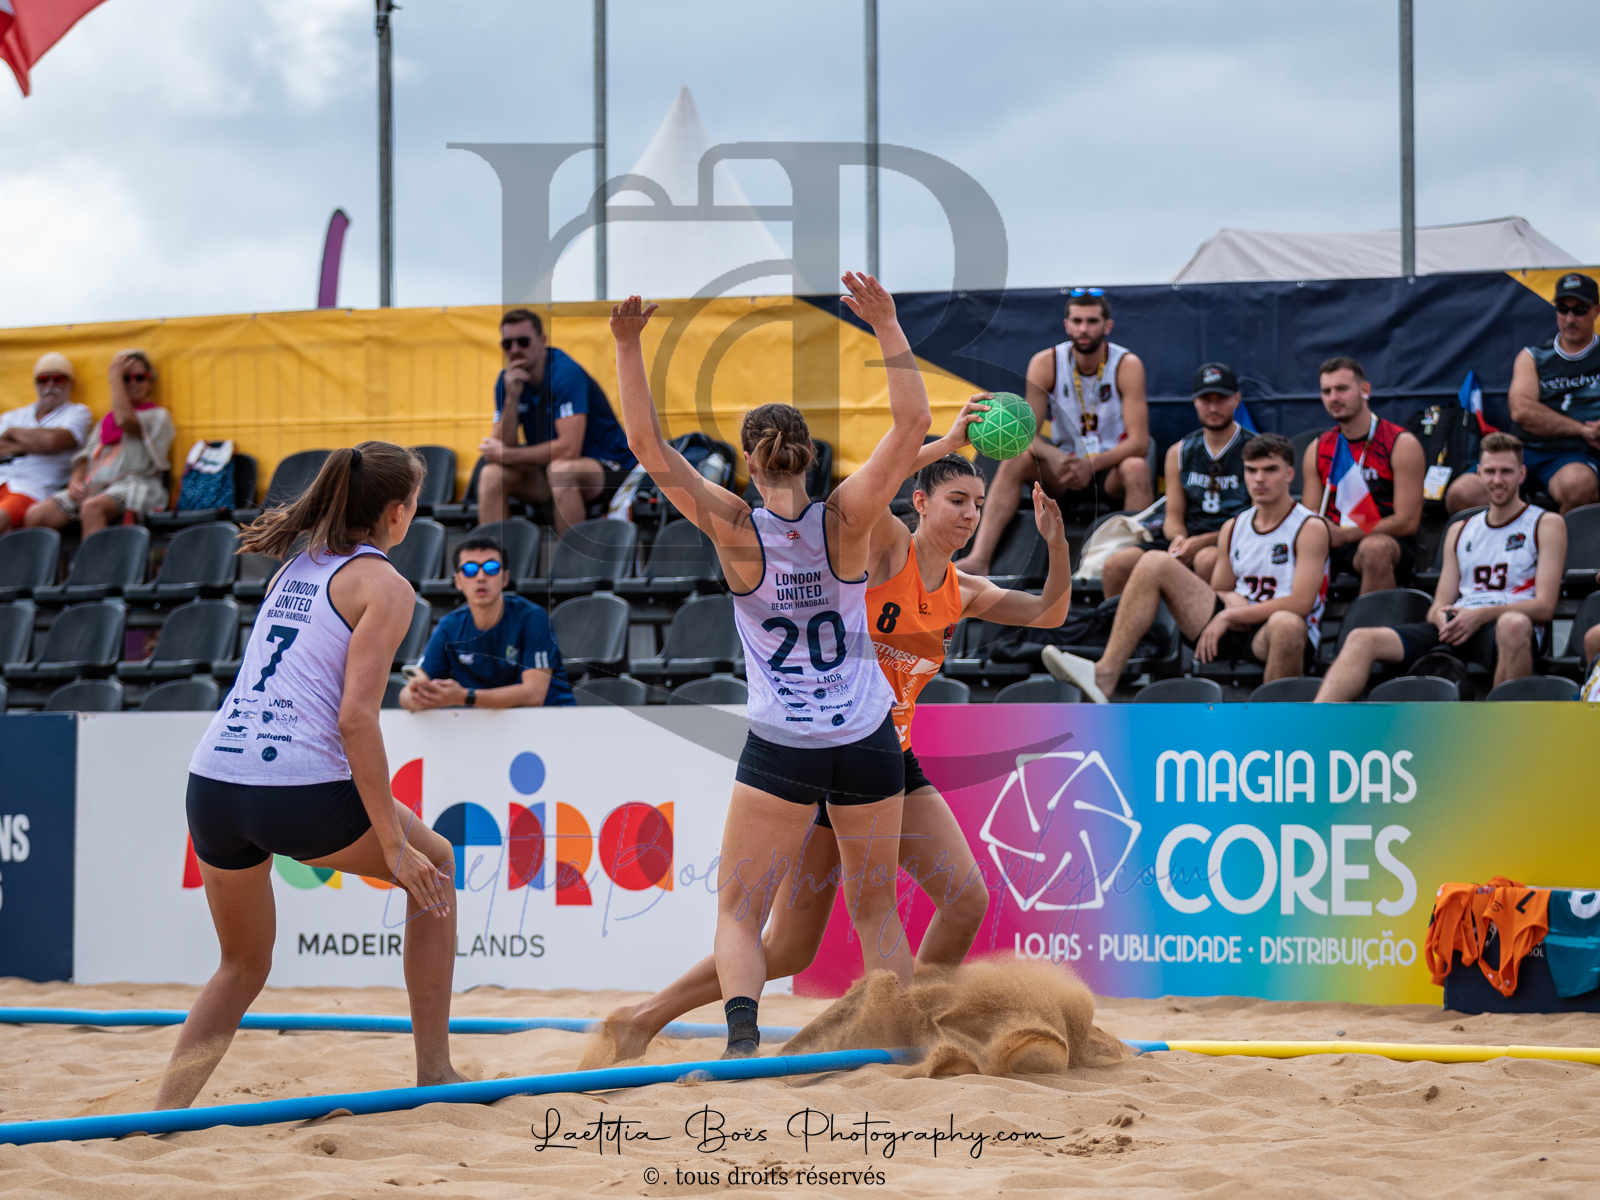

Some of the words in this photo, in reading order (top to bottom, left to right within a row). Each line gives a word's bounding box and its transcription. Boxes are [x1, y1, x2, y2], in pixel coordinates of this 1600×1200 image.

[775, 571, 821, 586] LONDON
[282, 579, 320, 597] LONDON
[776, 584, 822, 601] UNITED
[275, 595, 312, 612] UNITED
[771, 602, 793, 611] BEACH
[795, 597, 830, 609] HANDBALL
[267, 609, 284, 619] BEACH
[284, 610, 312, 624] HANDBALL
[876, 602, 901, 634] 8
[761, 610, 847, 675] 20
[252, 624, 300, 692] 7
[816, 674, 842, 684] LNDR
[828, 684, 849, 694] LSM
[268, 698, 294, 709] LNDR
[276, 712, 298, 723] LSM
[256, 732, 292, 742] pulseroll
[1155, 750, 1315, 803] MAGIA
[1329, 750, 1418, 803] DAS
[1155, 823, 1418, 917] CORES
[298, 933, 402, 956] MADEIR
[1014, 932, 1082, 961] LOJAS
[1099, 934, 1242, 963] PUBLICIDADE
[1260, 930, 1418, 969] DISTRIBUIÇÃO
